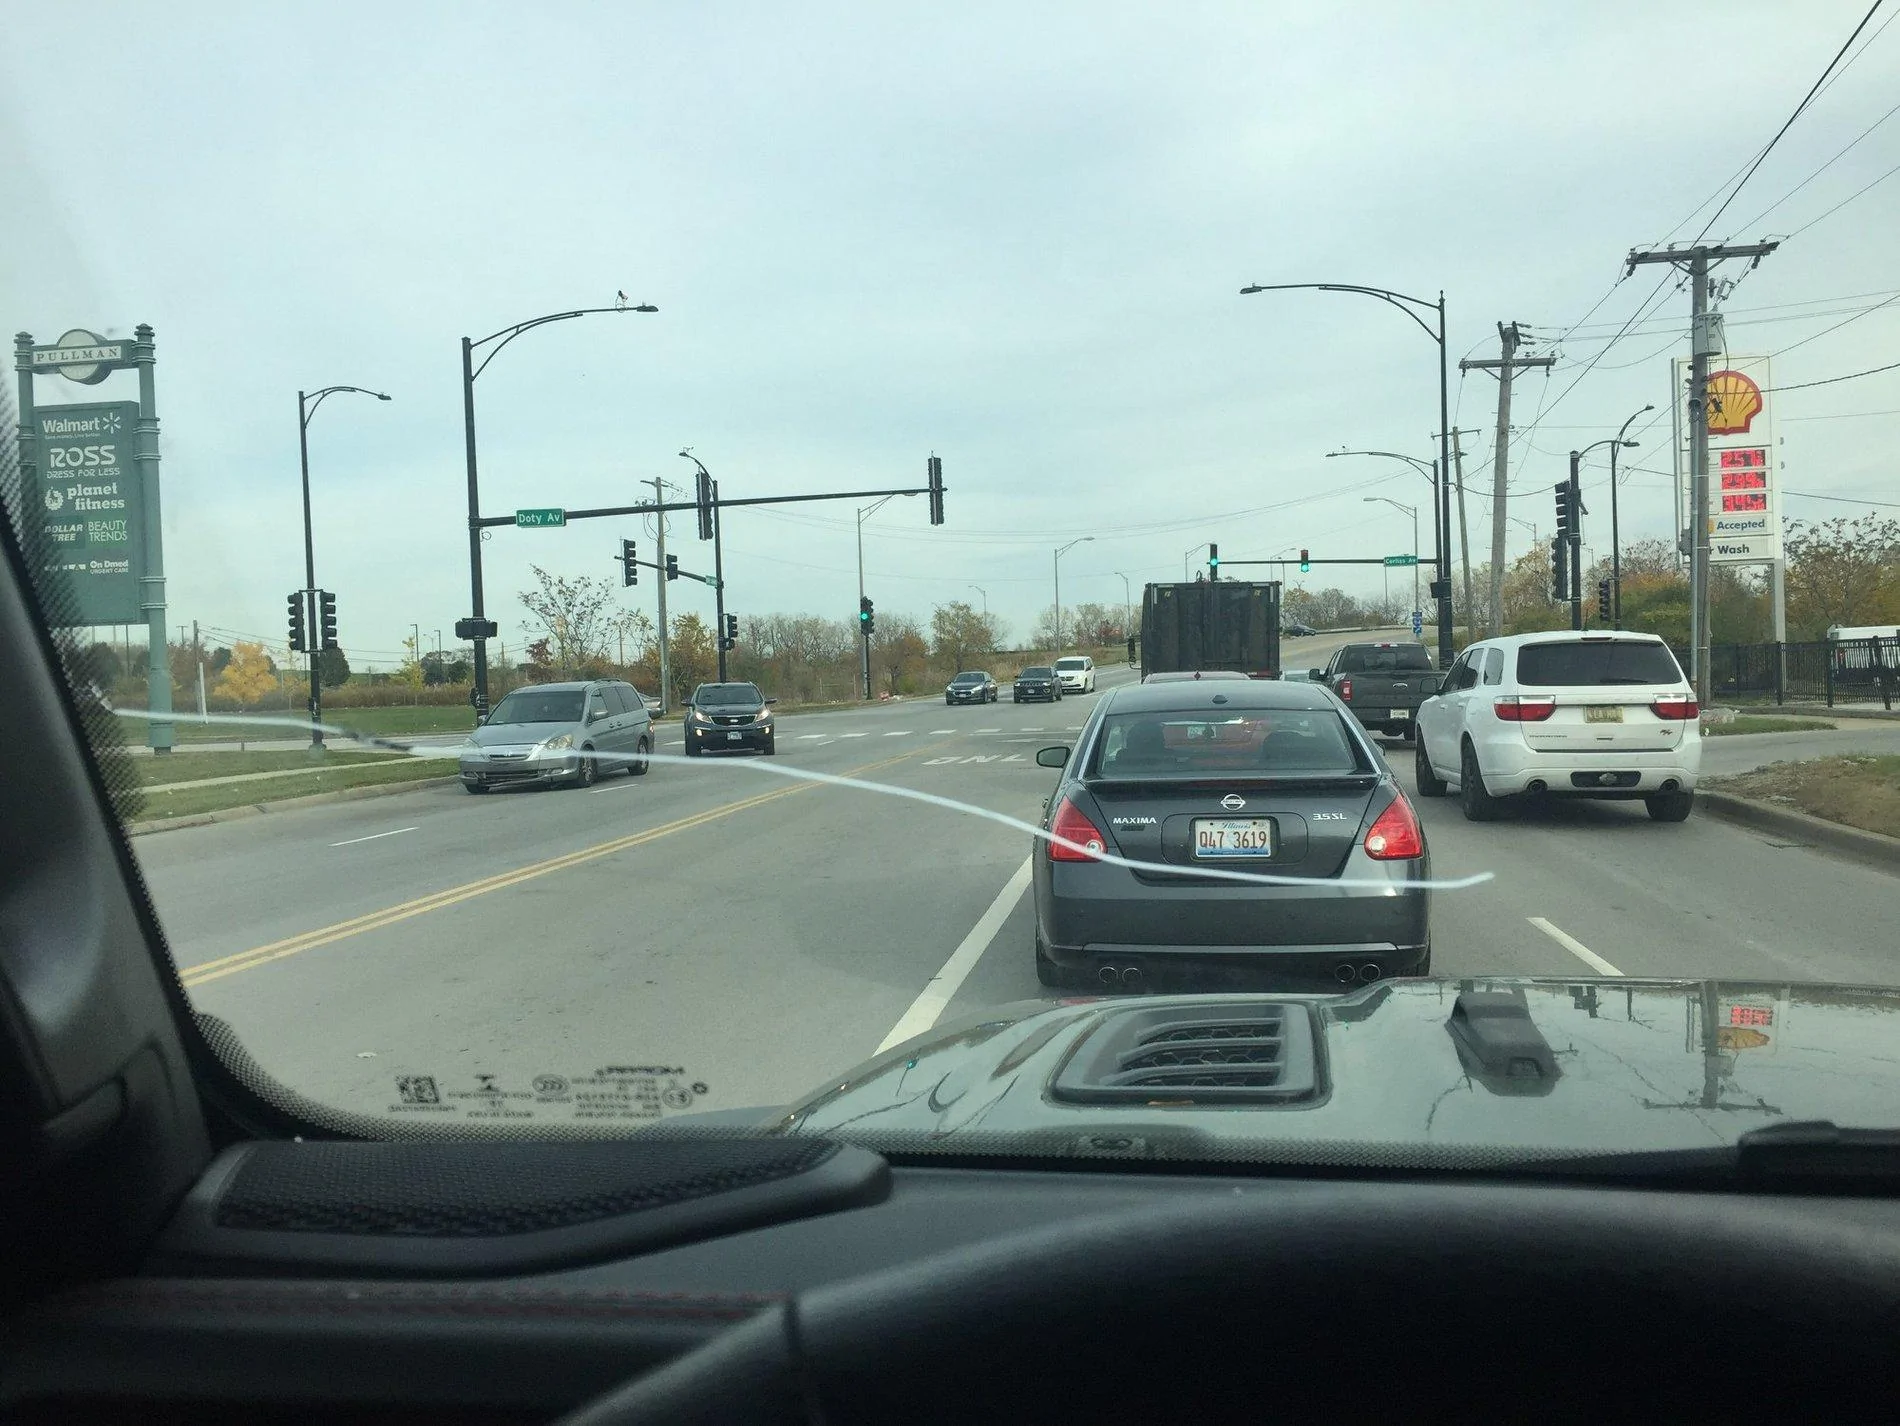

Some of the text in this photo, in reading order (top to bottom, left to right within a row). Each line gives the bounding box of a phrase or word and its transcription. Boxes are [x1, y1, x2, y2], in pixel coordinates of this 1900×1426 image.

[36, 347, 117, 362] PULLMAN
[42, 417, 100, 433] Walmart
[50, 445, 116, 468] ROSS
[46, 467, 120, 479] DRESS FOR LESS
[67, 482, 118, 500] planet
[74, 498, 125, 511] fitness
[518, 512, 560, 525] Doty Av
[44, 524, 83, 533] DOLLAR
[87, 520, 127, 531] BEAUTY
[1716, 519, 1765, 531] Accepted
[51, 533, 76, 542] TREE
[88, 531, 128, 541] TRENDS
[1717, 544, 1750, 555] Wash
[1233, 831, 1267, 849] 3619
